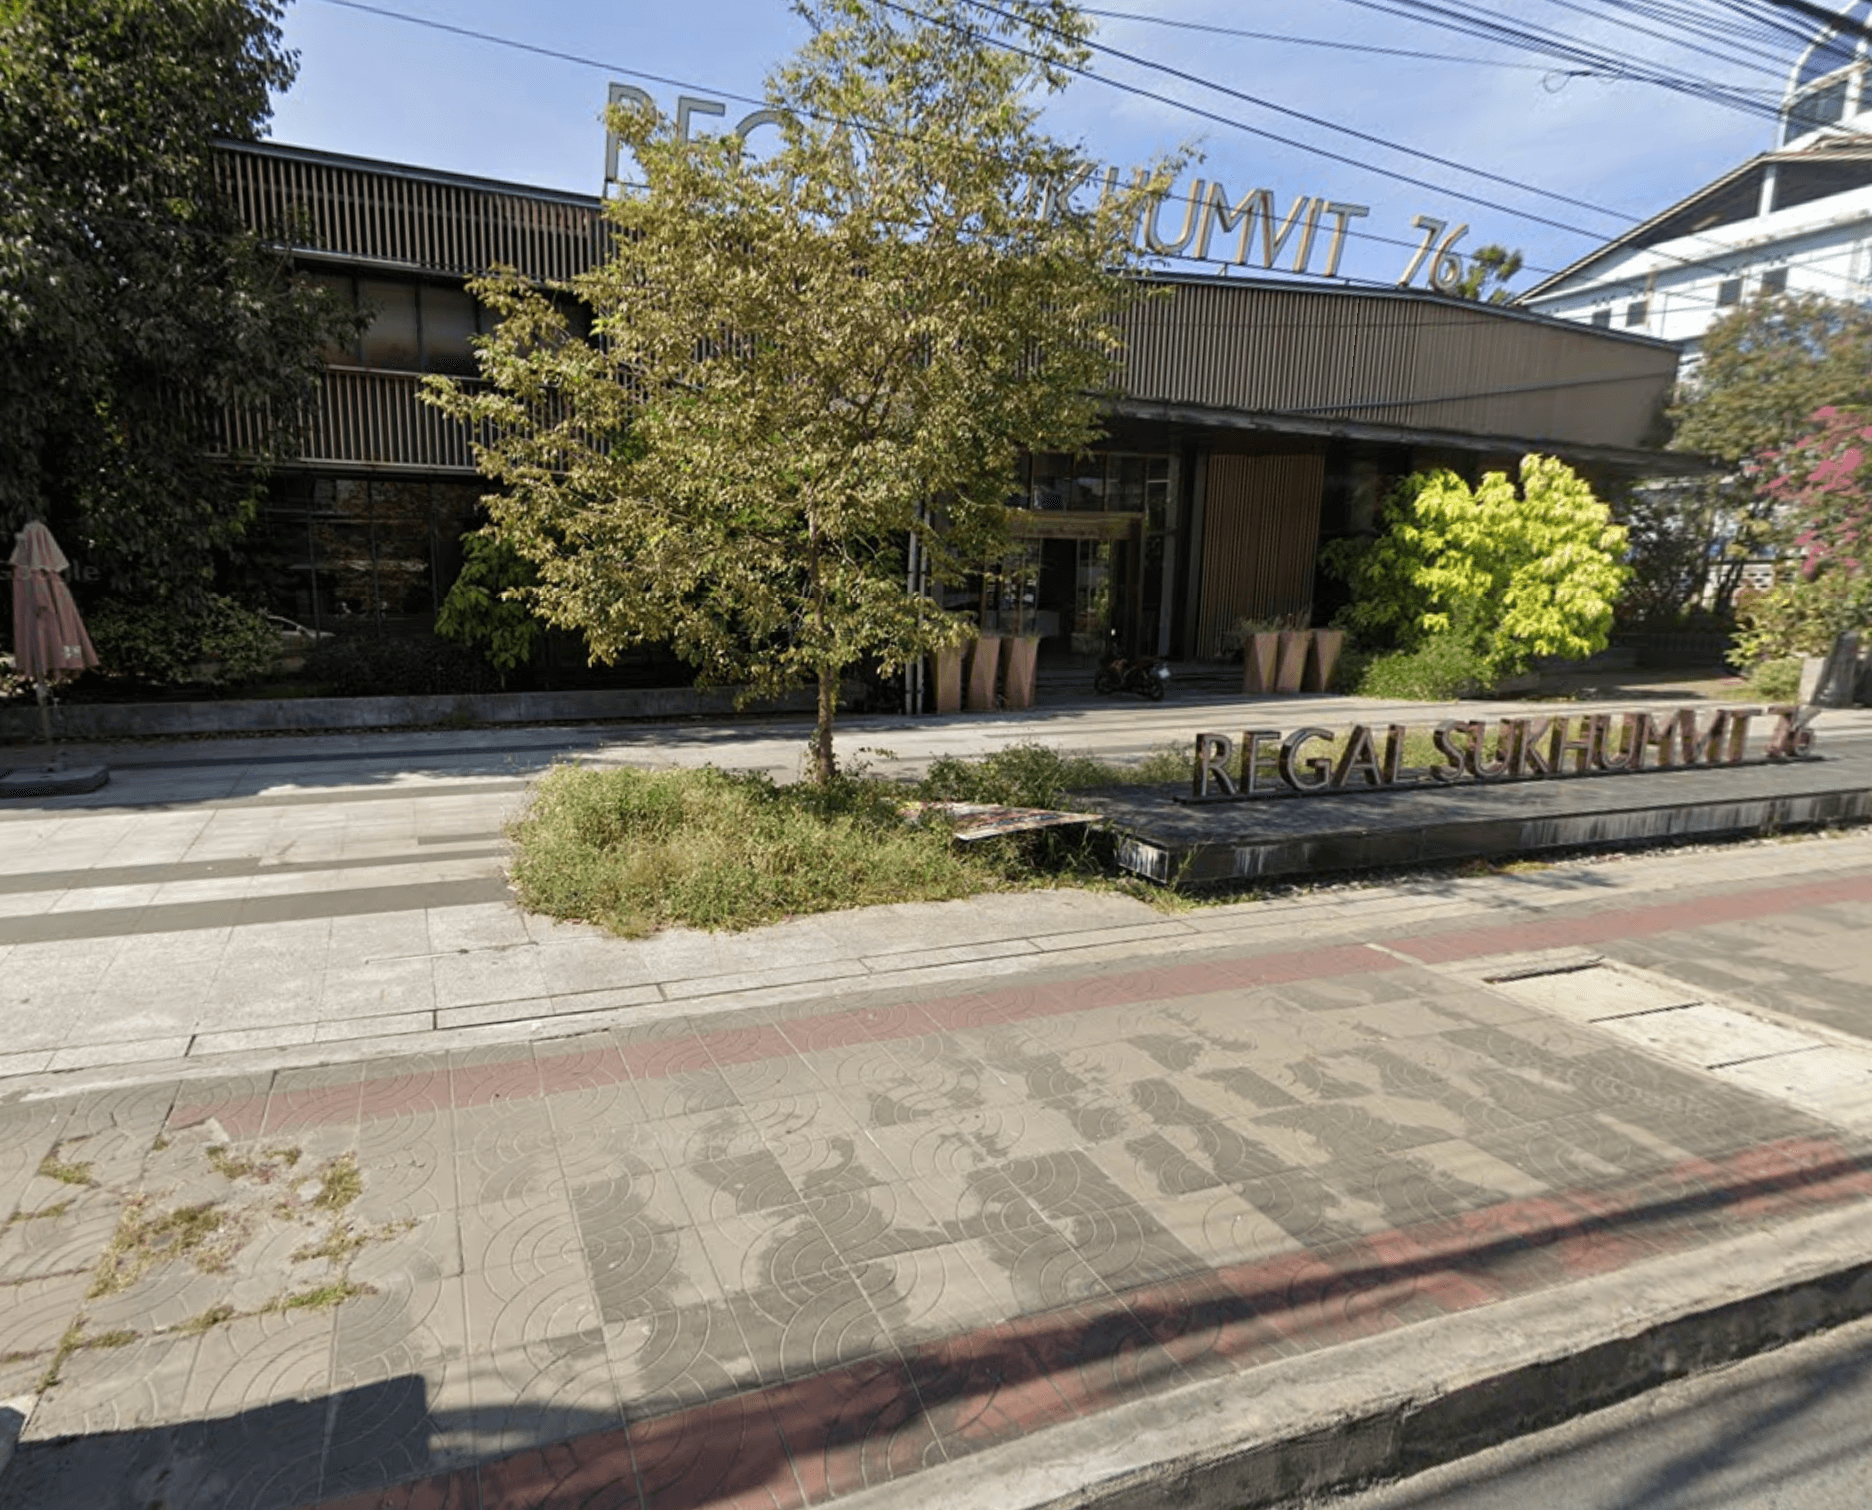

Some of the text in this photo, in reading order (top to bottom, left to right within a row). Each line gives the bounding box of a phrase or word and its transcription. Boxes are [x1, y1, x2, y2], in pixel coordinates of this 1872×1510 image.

[1397, 215, 1469, 294] 76
[1193, 723, 1419, 798] REGAL
[1430, 707, 1762, 780] SUKHUMVIT
